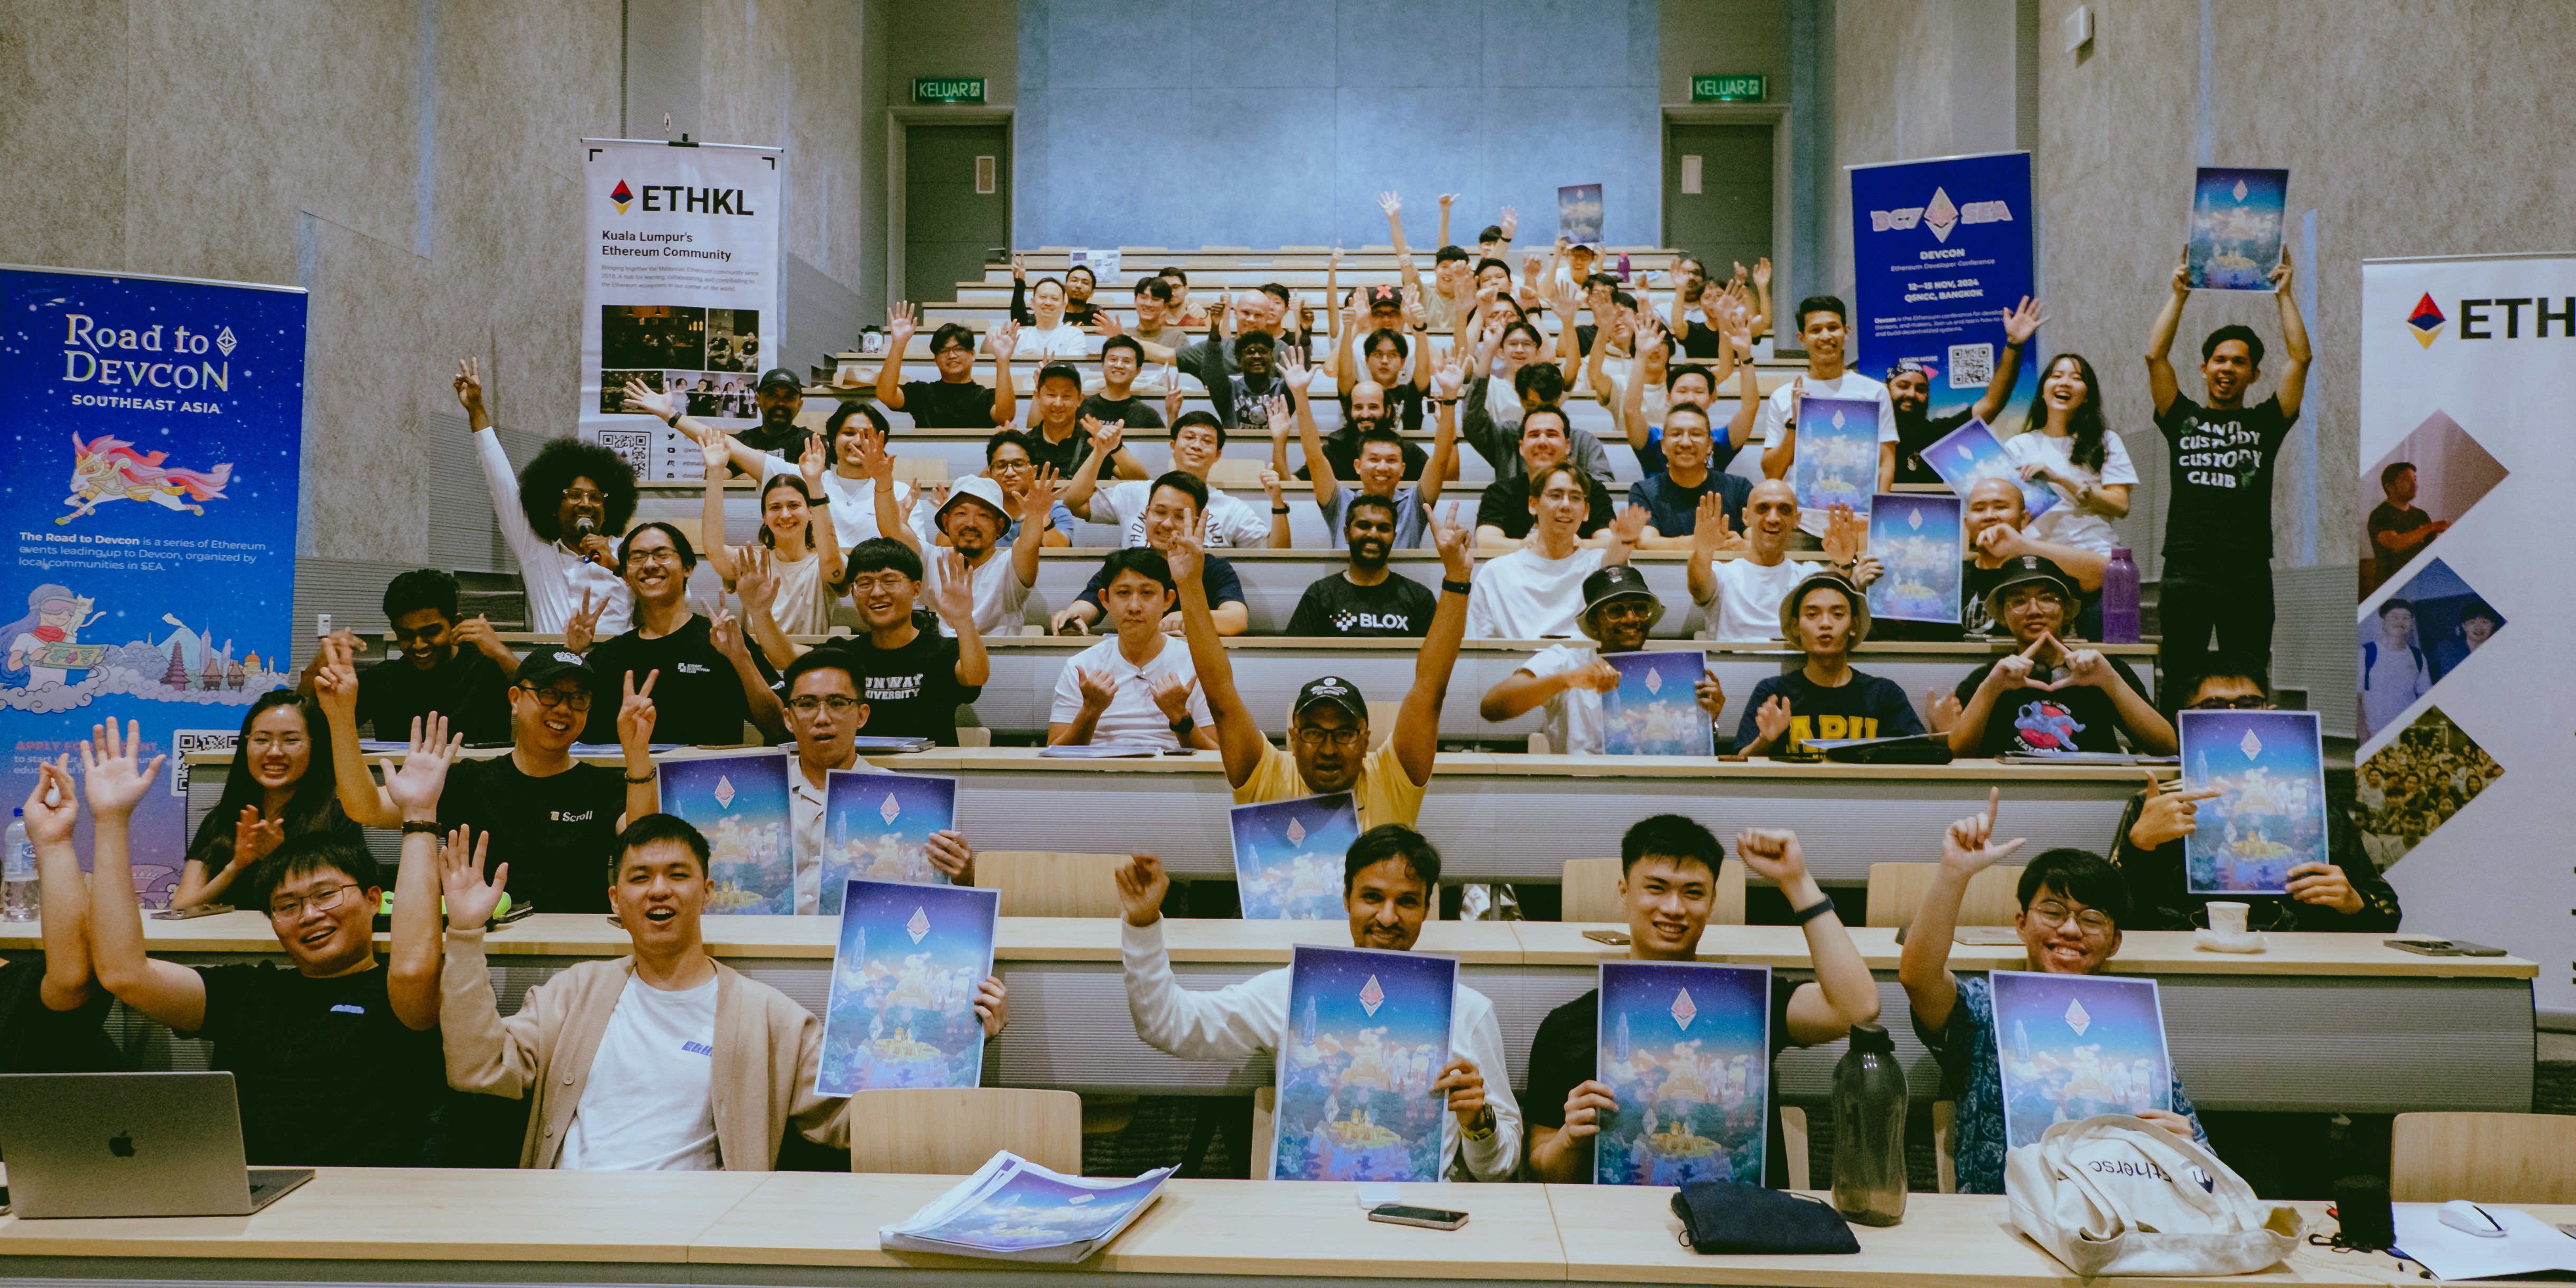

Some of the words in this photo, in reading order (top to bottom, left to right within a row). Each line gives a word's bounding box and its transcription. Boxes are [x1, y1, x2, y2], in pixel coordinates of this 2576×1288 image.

[919, 82, 968, 97] KELUAR
[1696, 80, 1746, 95] KELUAR
[643, 185, 754, 216] ETHKL
[1960, 200, 2013, 224] SEA
[602, 231, 636, 241] Kuala
[640, 232, 693, 244] Lumpur's
[602, 246, 659, 257] Ethereum
[663, 247, 731, 262] Community
[1920, 248, 1966, 260] DEVCON
[1935, 281, 1957, 290] NOV,
[1957, 278, 1979, 287] 2024
[1904, 293, 1938, 303] QSNCC,
[1939, 289, 1984, 300] BANGKOK
[2460, 296, 2576, 340] ETH
[64, 314, 163, 353] Road
[174, 325, 209, 354] to
[63, 350, 228, 391] DEVCON
[72, 395, 175, 411] SOUTHEAST
[181, 402, 220, 414] ASIA
[2197, 421, 2242, 436] ANTI
[2187, 471, 2236, 488] CLUB
[20, 532, 42, 542] The
[46, 533, 77, 543] Road
[79, 535, 92, 543] to
[95, 535, 140, 546] Devcon
[143, 537, 151, 546] is
[163, 538, 195, 548] series
[198, 538, 209, 548] of
[211, 539, 266, 550] Ethereum
[20, 547, 57, 555] events
[61, 546, 103, 558] leading
[106, 550, 121, 559] up
[124, 549, 135, 558] to
[138, 548, 183, 561] Devcon,
[185, 552, 239, 564] organized
[243, 551, 256, 564] by
[18, 558, 45, 567] local
[48, 559, 124, 570] communities
[127, 562, 137, 570] in
[1360, 612, 1409, 631] BLOX
[866, 673, 924, 689] UNWAY
[15, 742, 62, 751] APPLY
[562, 810, 593, 823] Scroll
